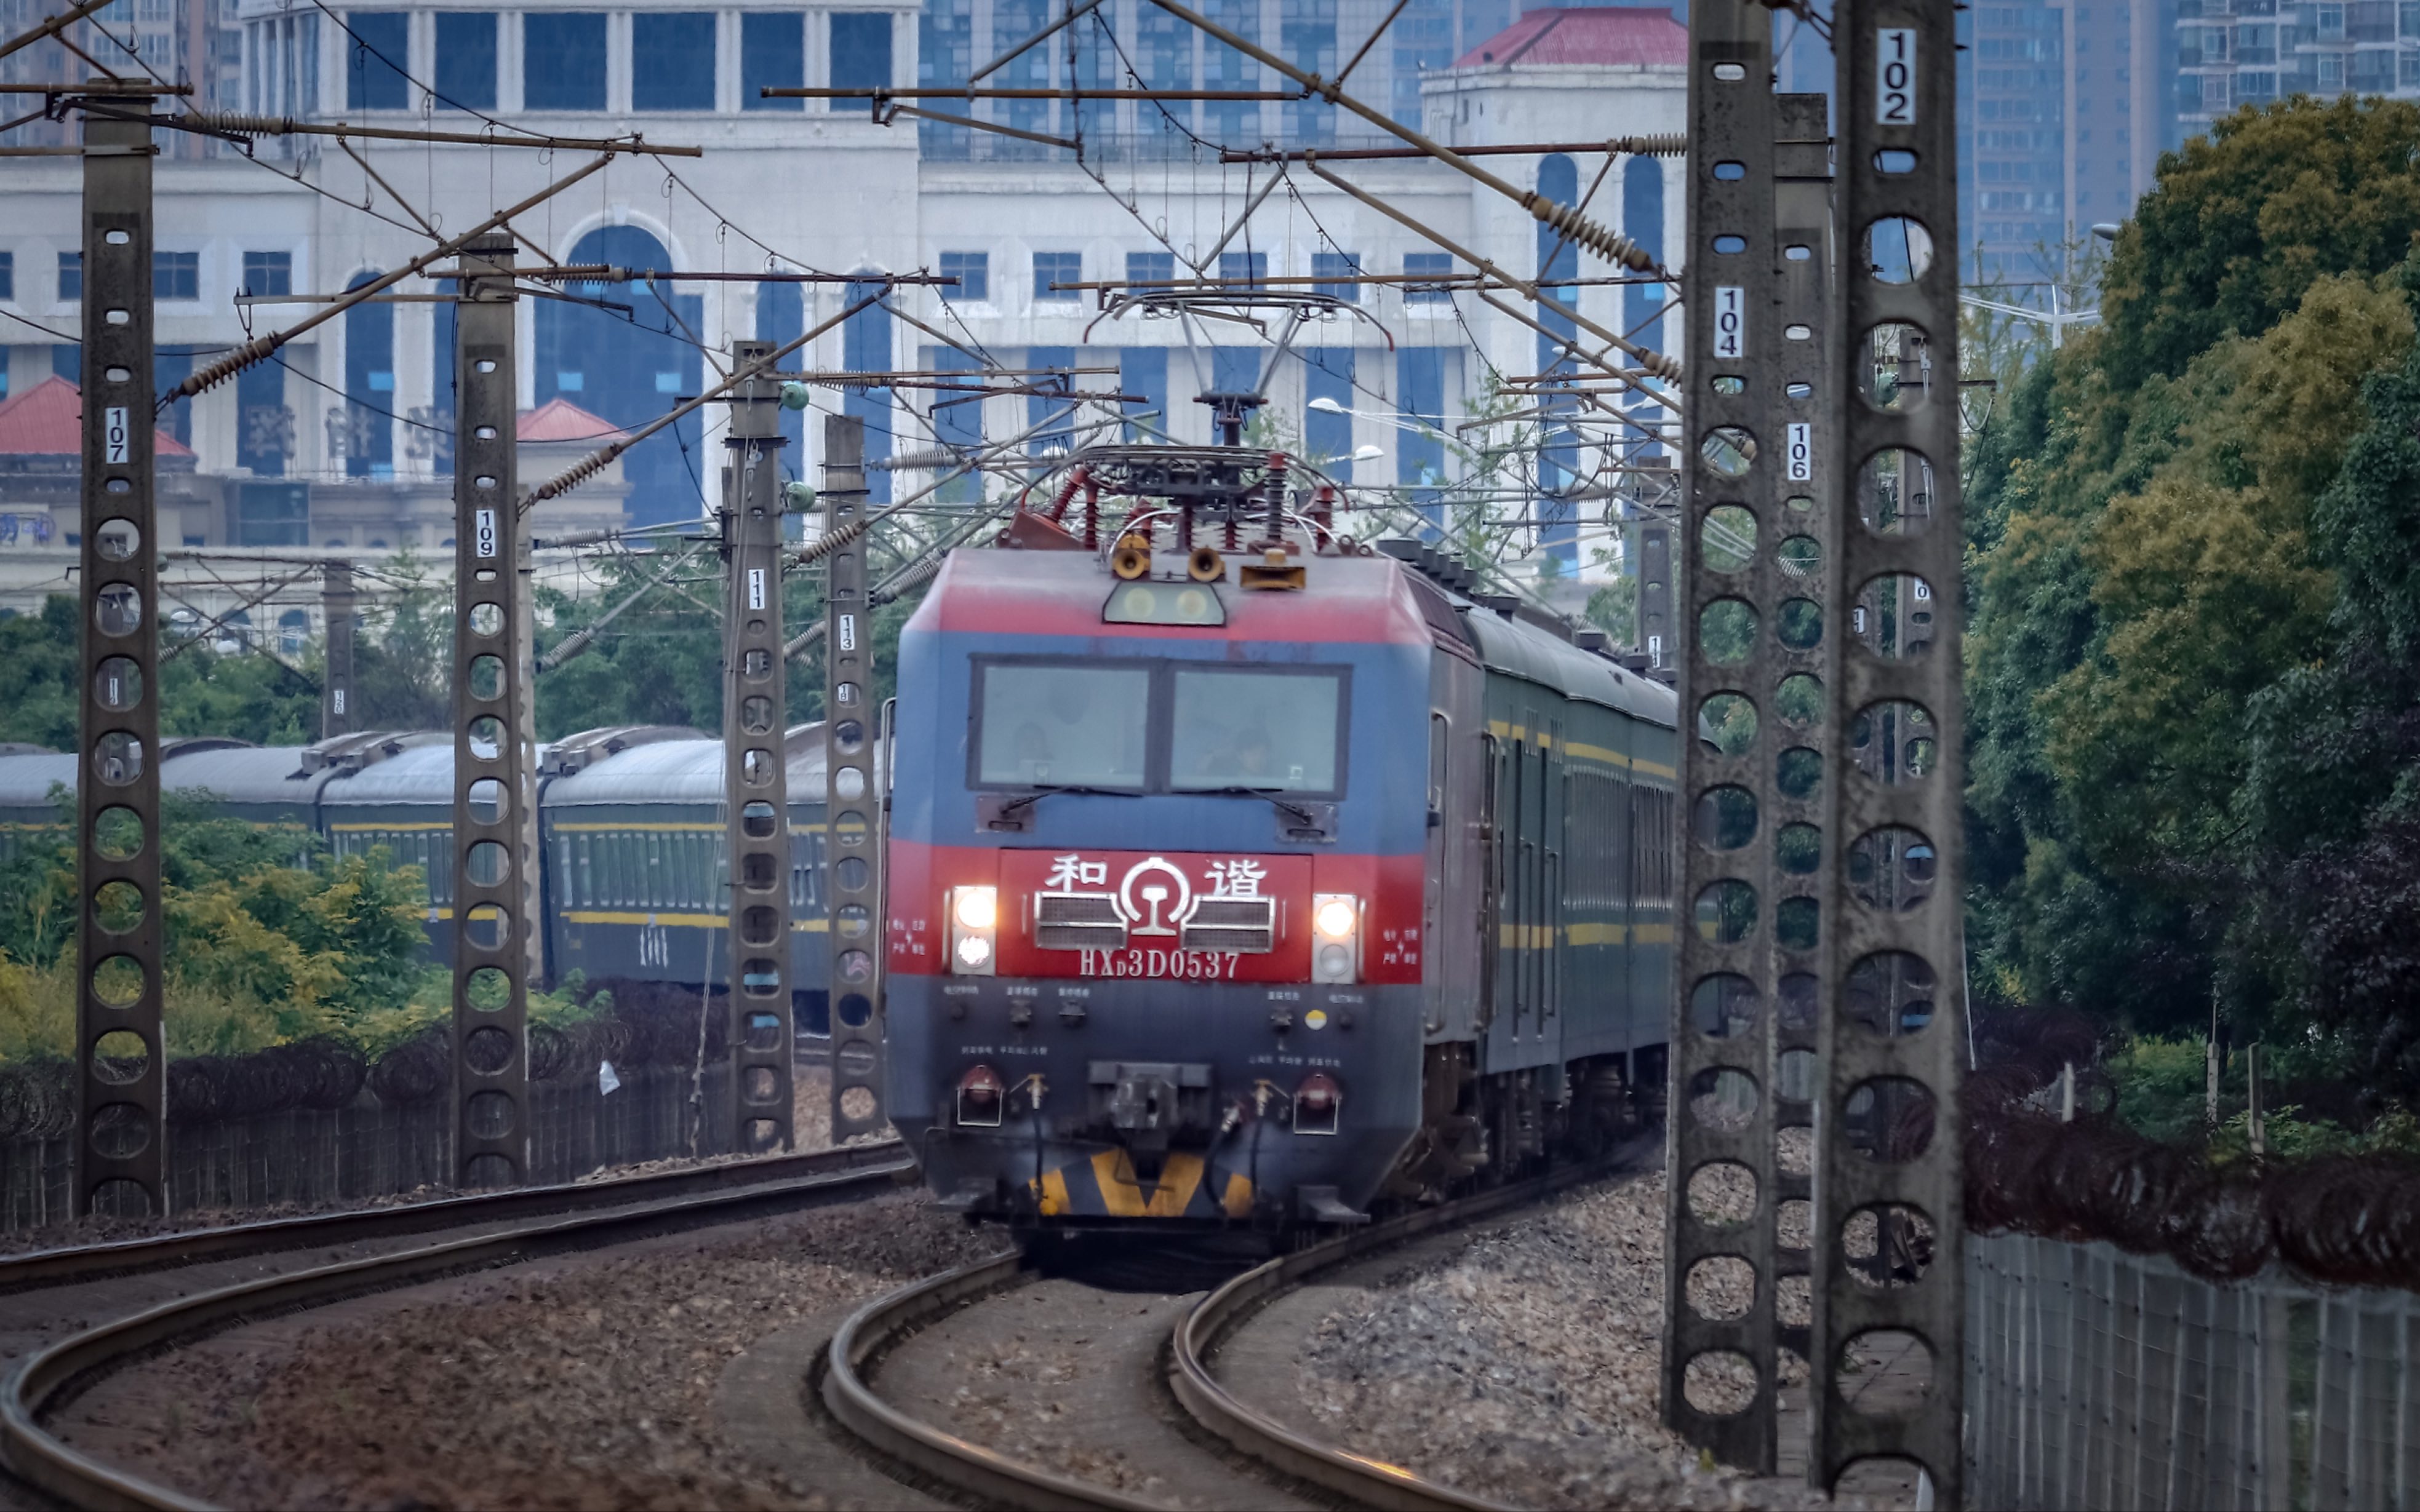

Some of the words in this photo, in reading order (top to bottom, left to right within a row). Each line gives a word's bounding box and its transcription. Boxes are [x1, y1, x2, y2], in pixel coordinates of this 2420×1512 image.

[1885, 31, 1908, 120] 102
[1719, 289, 1738, 356] 104
[110, 408, 124, 463] 107
[1792, 425, 1807, 479] 106
[480, 511, 493, 556] 109
[752, 570, 761, 608] 111
[842, 615, 853, 650] 113
[1045, 854, 1107, 892] 和
[1204, 859, 1267, 897] 谐
